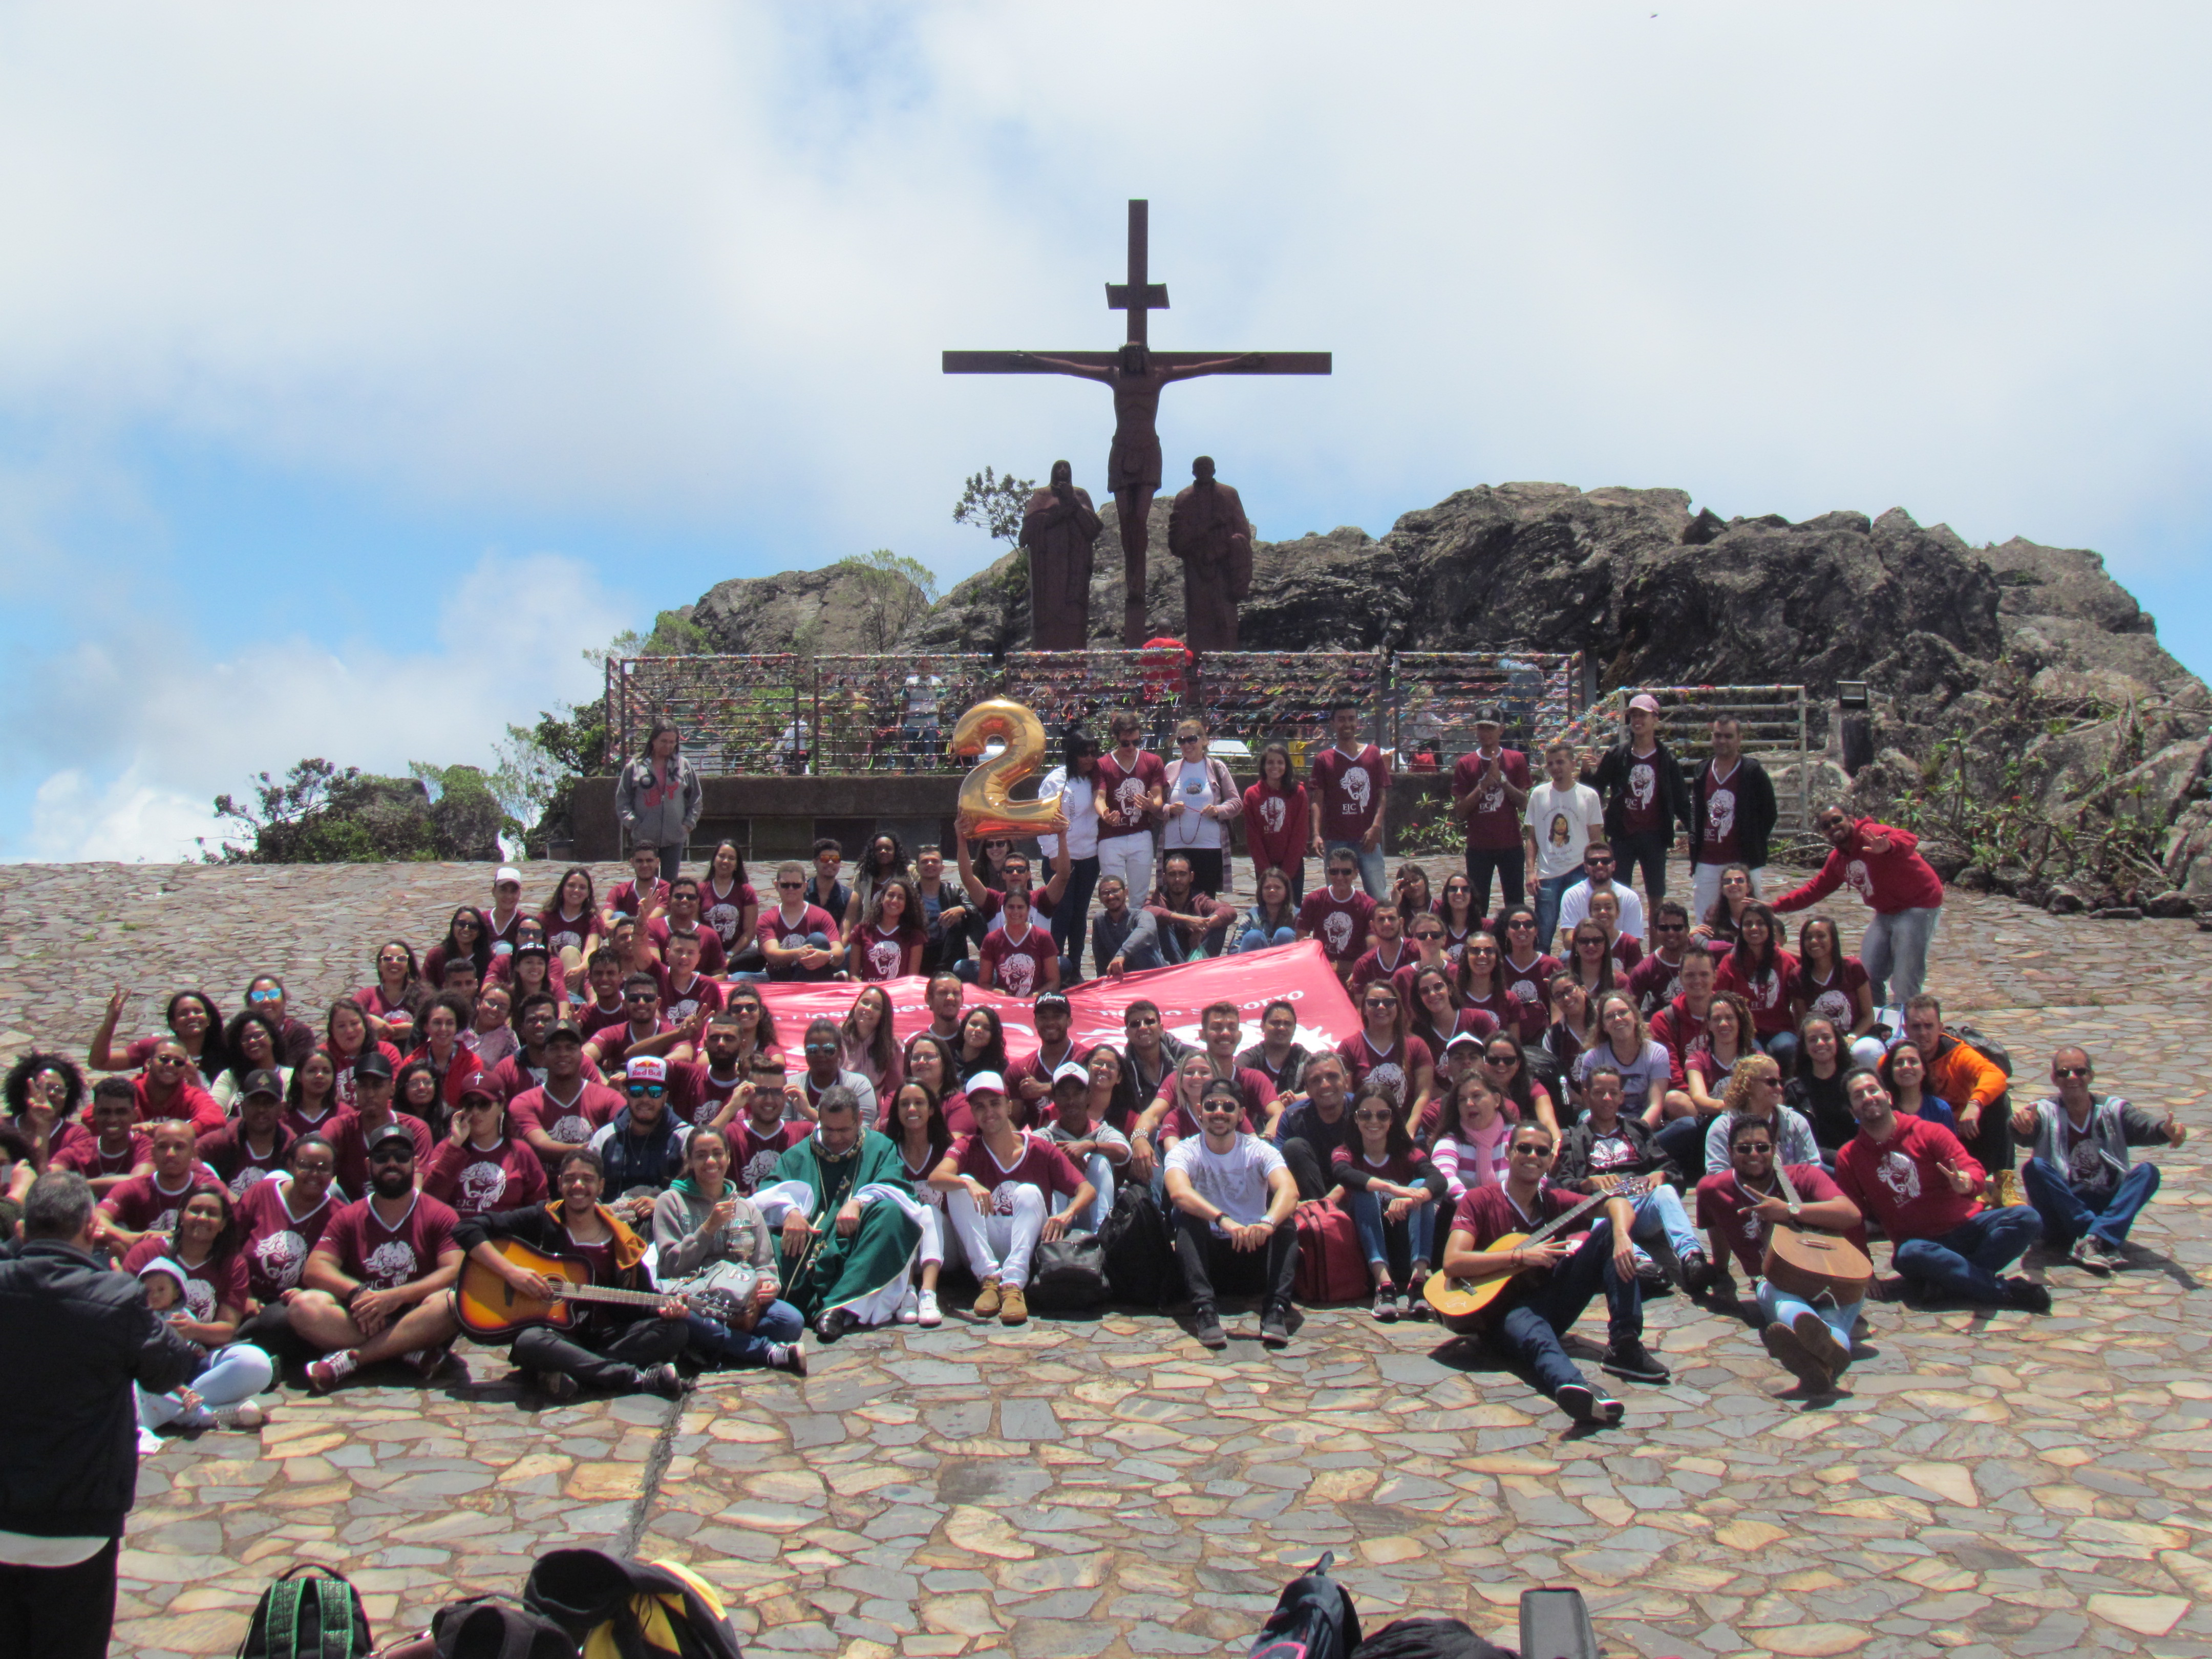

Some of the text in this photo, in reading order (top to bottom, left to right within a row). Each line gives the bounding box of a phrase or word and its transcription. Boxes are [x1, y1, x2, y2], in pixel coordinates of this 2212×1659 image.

[1343, 803, 1356, 812] EJC
[632, 1068, 662, 1077] Red Bull
